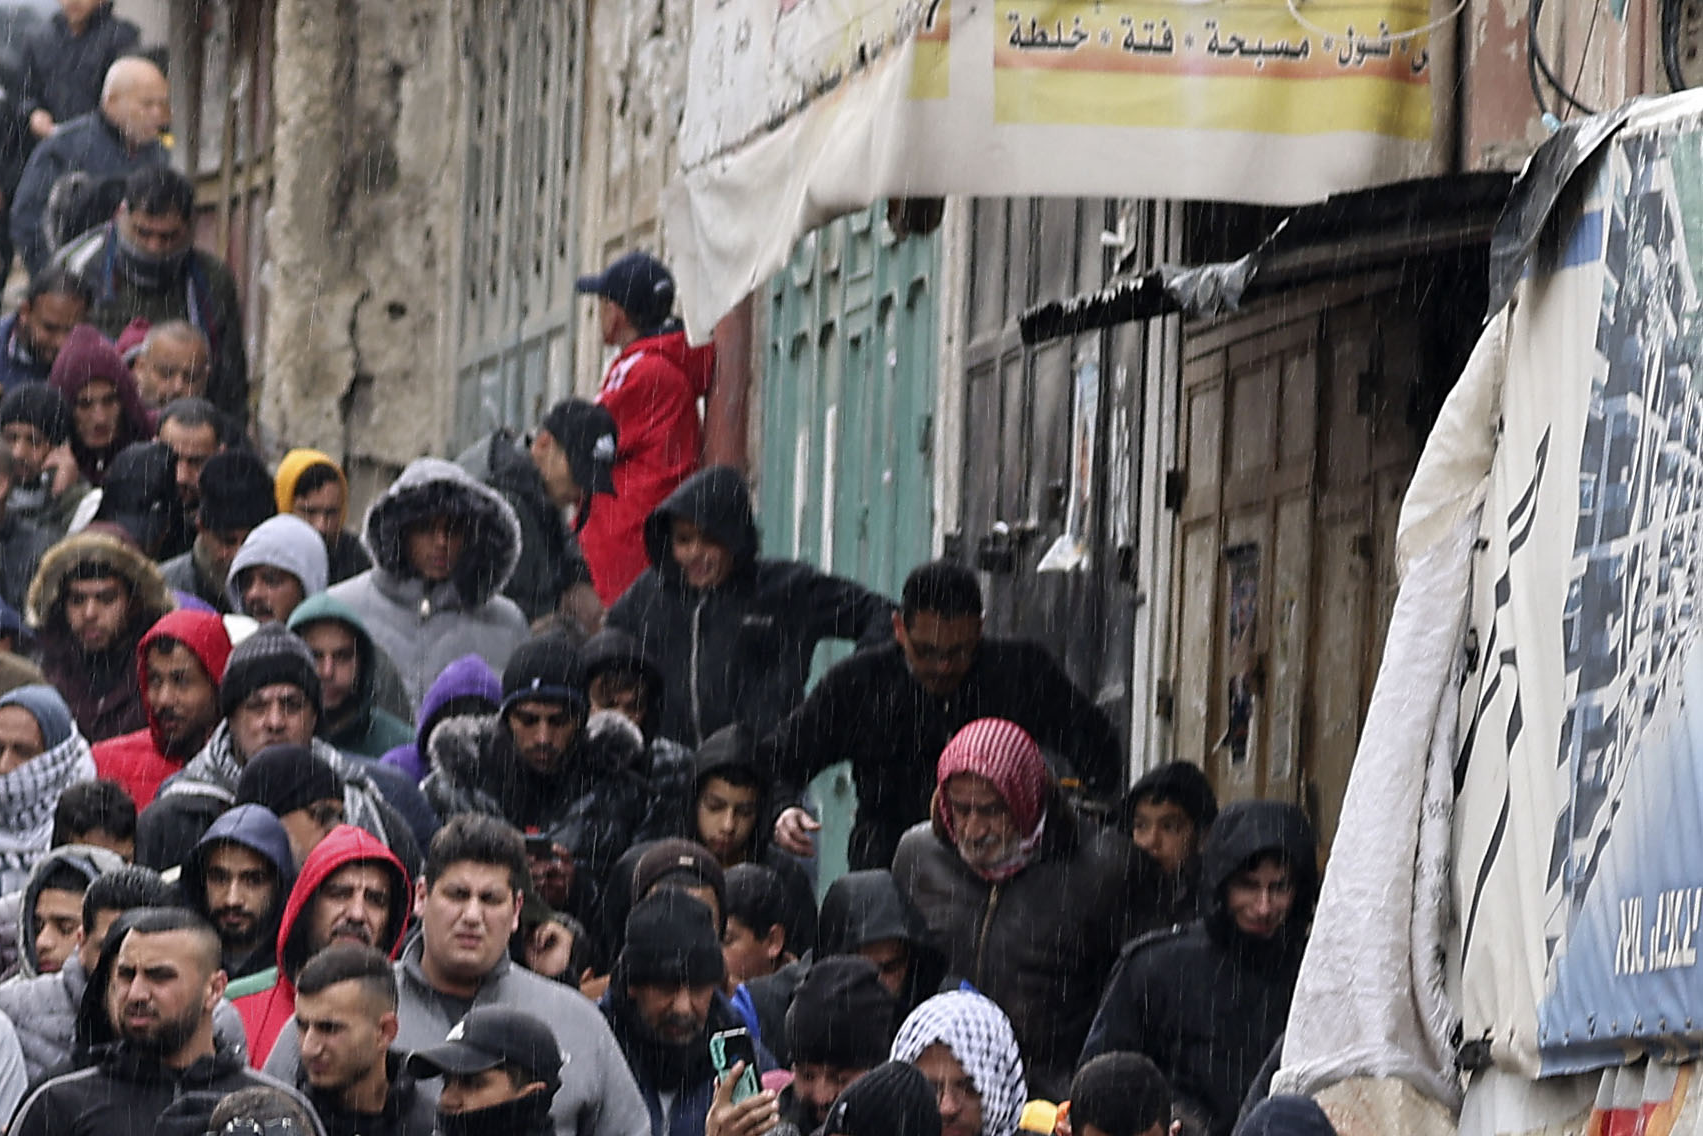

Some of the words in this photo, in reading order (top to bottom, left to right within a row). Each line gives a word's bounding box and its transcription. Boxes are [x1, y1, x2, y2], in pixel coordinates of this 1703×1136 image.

[1008, 10, 1089, 51] خلطة
[1121, 16, 1175, 54] فتة
[1206, 19, 1310, 69] مسبحة
